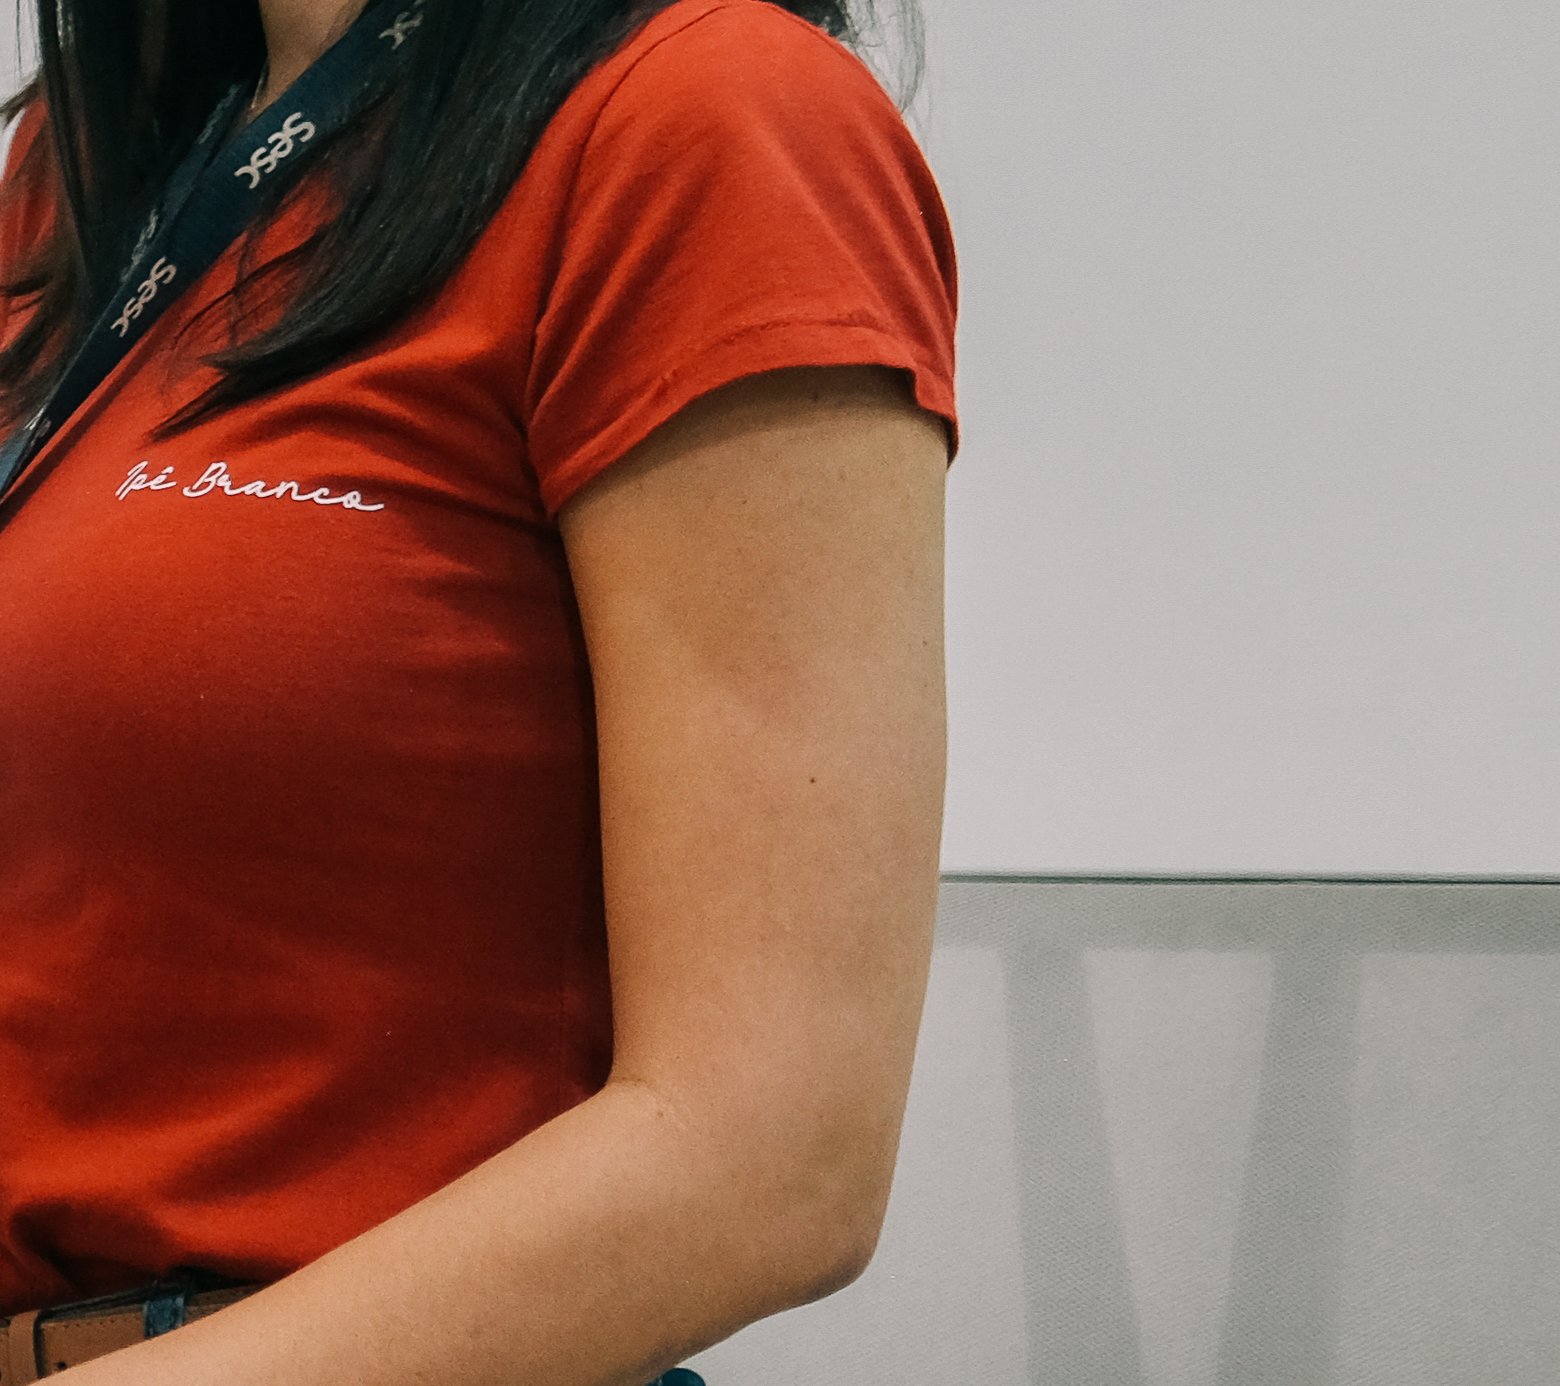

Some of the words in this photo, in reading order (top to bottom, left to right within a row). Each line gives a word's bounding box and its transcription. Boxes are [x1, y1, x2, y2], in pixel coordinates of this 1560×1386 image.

[234, 111, 316, 190] Sesc
[110, 256, 178, 338] Sesc
[114, 460, 178, 500] Ipê
[181, 462, 386, 512] Branco
